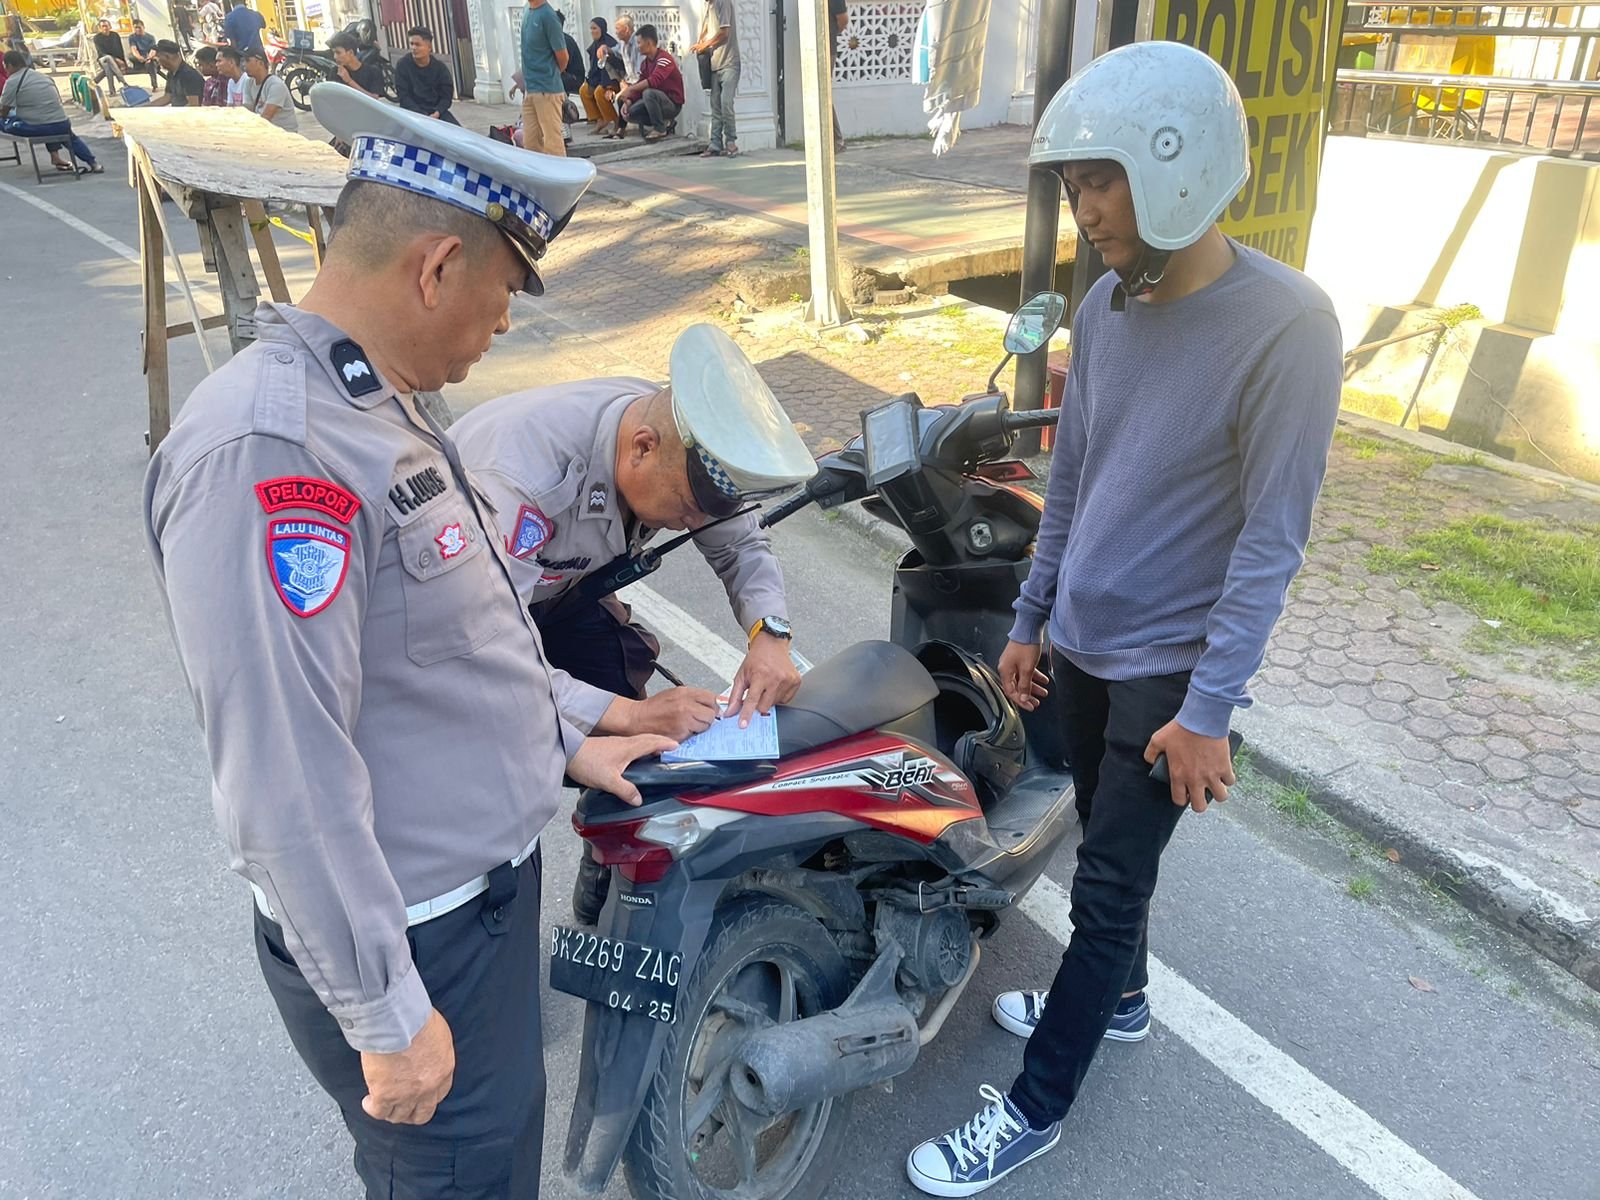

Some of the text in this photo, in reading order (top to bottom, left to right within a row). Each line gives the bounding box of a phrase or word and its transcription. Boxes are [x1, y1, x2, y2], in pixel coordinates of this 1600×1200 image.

[1217, 112, 1320, 223] SEK
[268, 483, 349, 514] PELOPOR
[275, 523, 344, 544] LALU LINTAS
[771, 780, 806, 789] Compact
[620, 893, 653, 905] HONDA
[635, 946, 681, 986] ZAG
